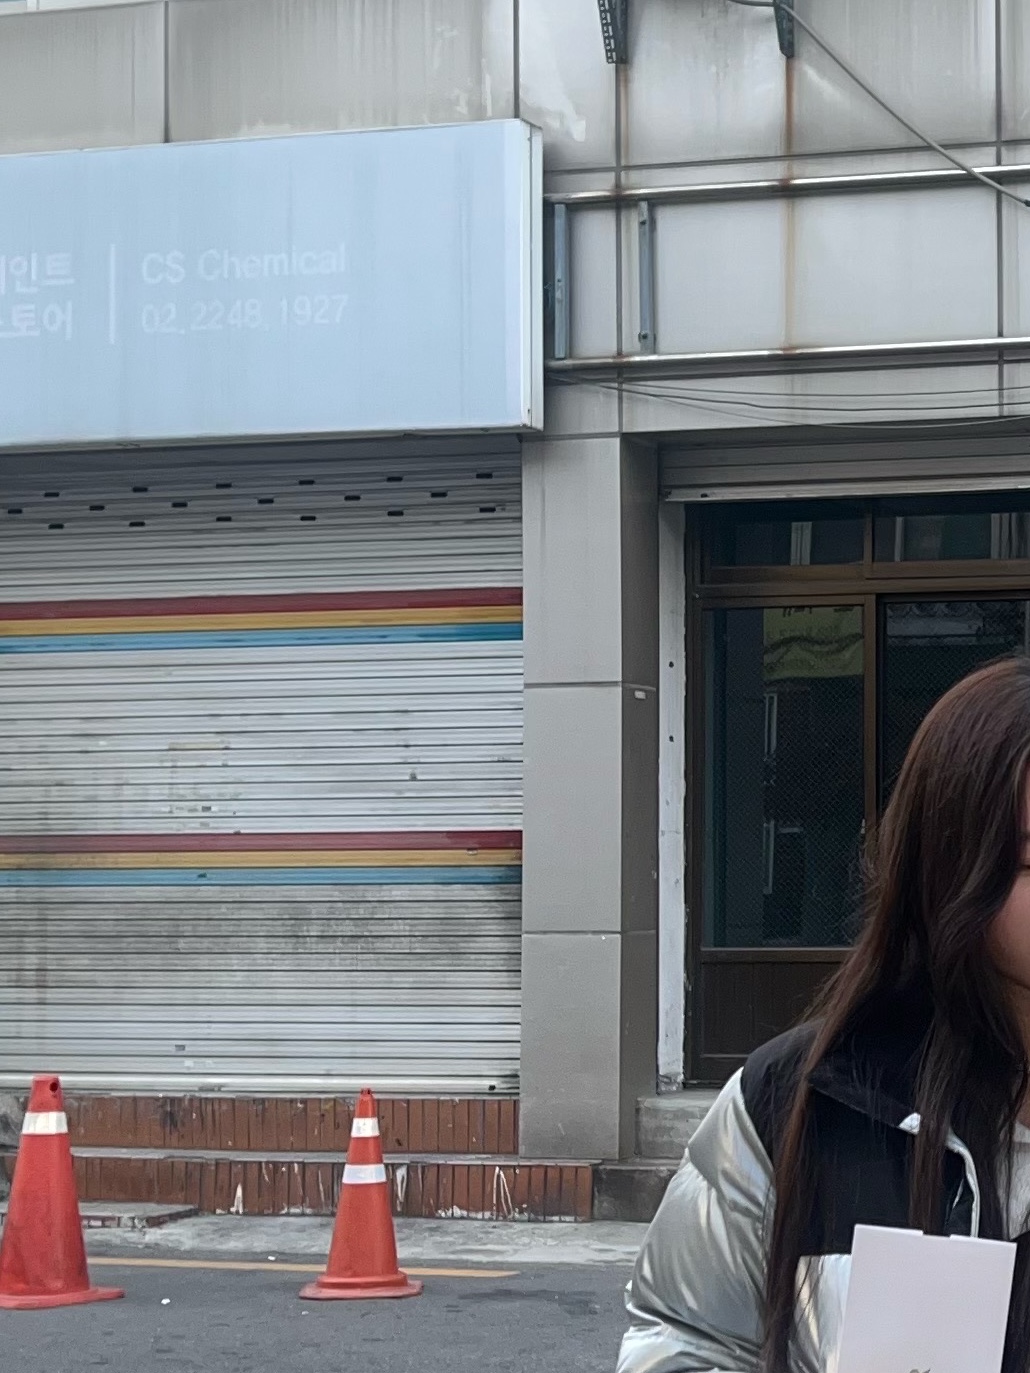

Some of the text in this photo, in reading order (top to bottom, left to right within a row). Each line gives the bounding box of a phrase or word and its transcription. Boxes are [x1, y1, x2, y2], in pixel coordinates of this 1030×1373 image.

[0, 252, 76, 295] 인트
[142, 242, 345, 284] CS Chemical
